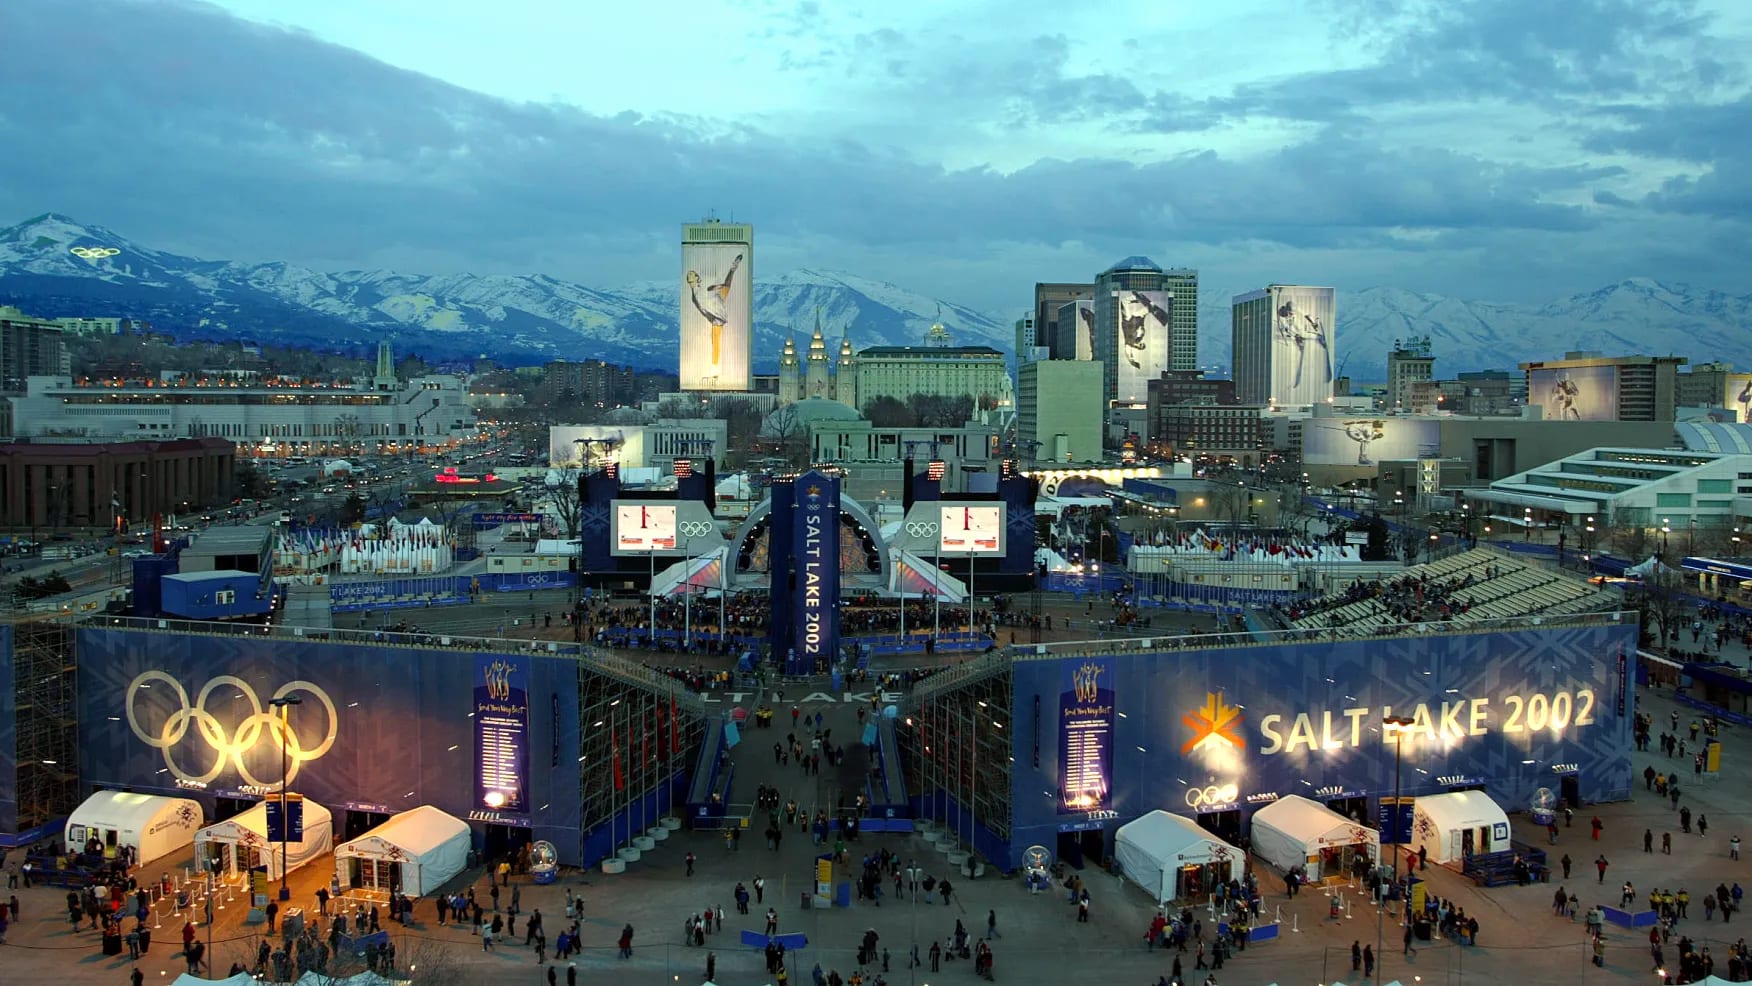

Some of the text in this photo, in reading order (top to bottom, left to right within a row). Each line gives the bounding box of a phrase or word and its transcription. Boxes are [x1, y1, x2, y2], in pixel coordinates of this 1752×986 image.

[805, 515, 820, 653] SALT LAKE 2002
[771, 692, 904, 703] LAKE
[1260, 690, 1595, 756] SALT LAKE 2002
